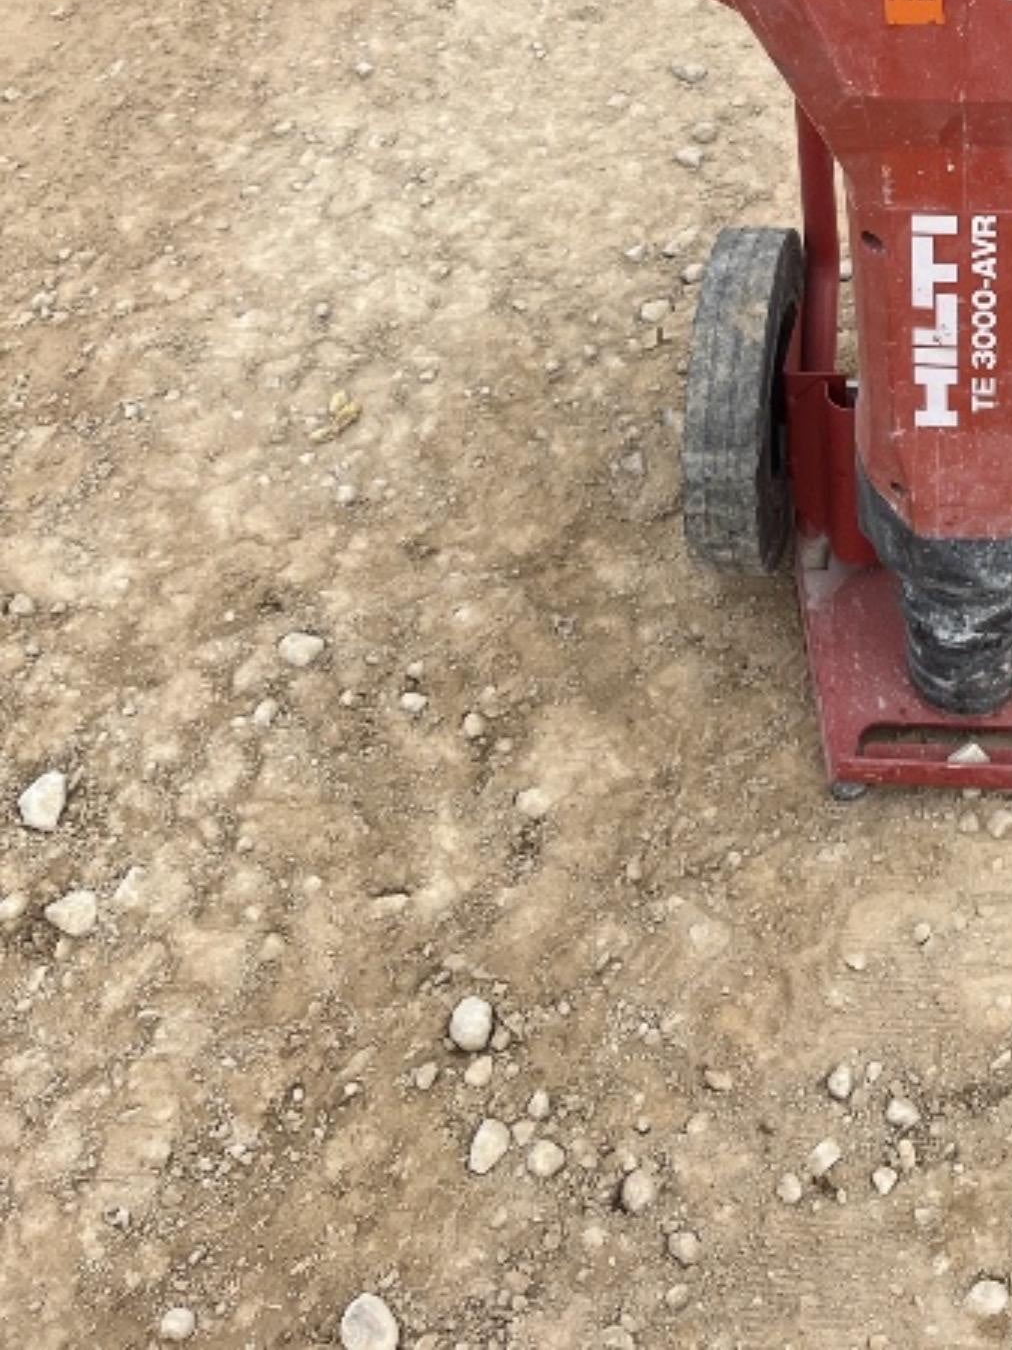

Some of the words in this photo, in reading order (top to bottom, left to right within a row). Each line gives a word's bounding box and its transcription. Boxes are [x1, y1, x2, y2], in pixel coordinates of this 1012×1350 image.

[911, 214, 958, 428] HILTI
[970, 215, 998, 370] 3000-AVR
[970, 377, 997, 413] TE
